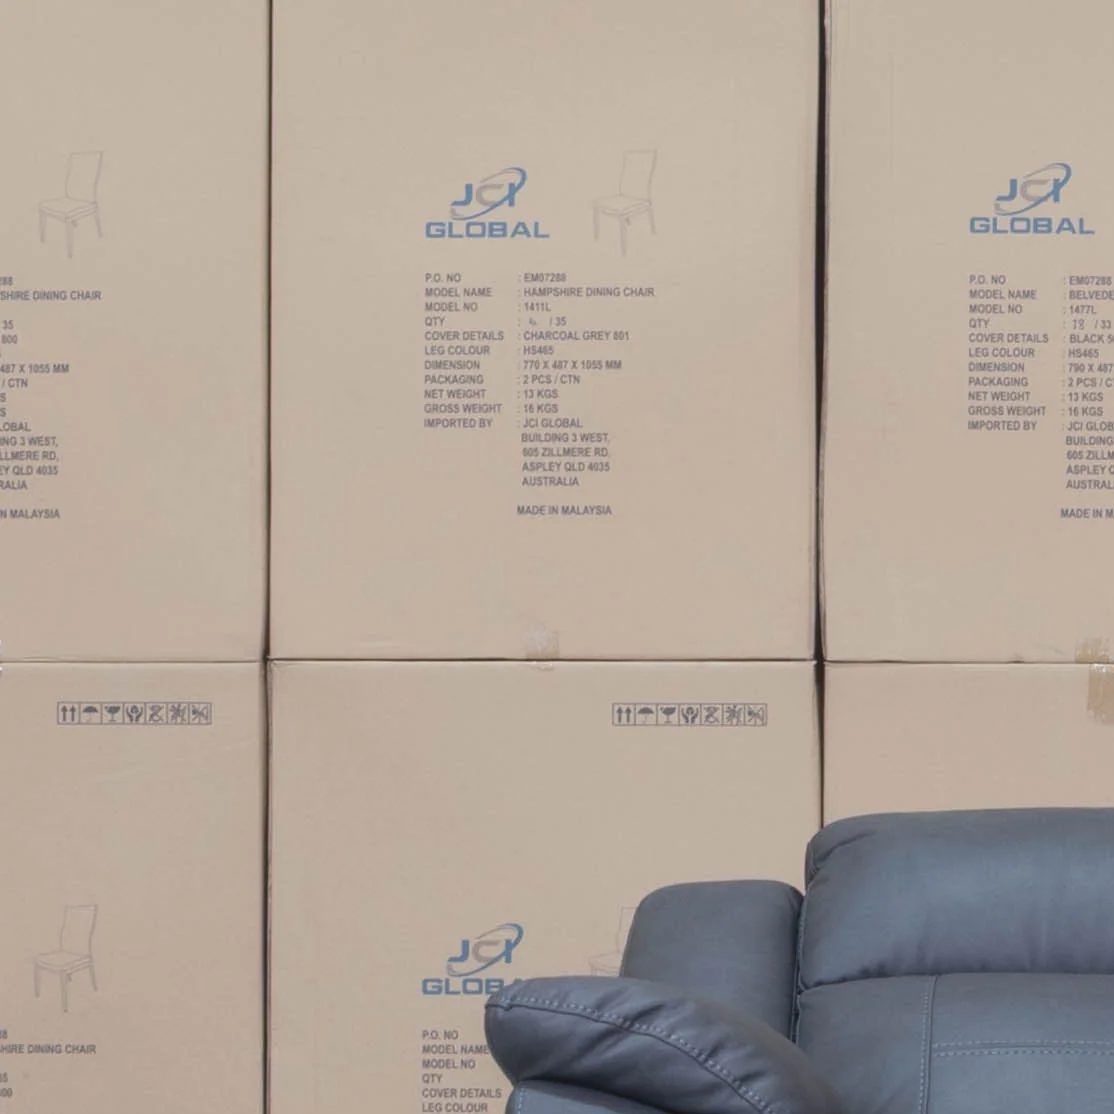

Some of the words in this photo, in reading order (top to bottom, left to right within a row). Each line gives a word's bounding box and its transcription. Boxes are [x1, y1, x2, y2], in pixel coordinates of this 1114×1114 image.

[426, 221, 550, 238] GLOBAL
[970, 217, 1095, 234] GLOBAL
[32, 290, 68, 301] DINING
[70, 290, 102, 301] CHAIR
[425, 287, 460, 297] MODEL
[463, 287, 493, 297] NAME
[524, 287, 583, 297] HAMPSHIRE
[586, 287, 621, 297] DINING
[623, 287, 655, 297] CHAIR
[969, 289, 1005, 299] MODEL
[1008, 289, 1037, 299] NAME
[424, 302, 461, 312] MODEL
[524, 302, 552, 312] 1411L
[969, 304, 1005, 314] MODEL
[1069, 304, 1097, 315] 1477L
[424, 316, 445, 327] QTY
[968, 318, 990, 329] QTY
[424, 331, 460, 341] COVER
[462, 331, 504, 341] DETAILS
[523, 330, 580, 341] CHARCOAL
[582, 330, 611, 341] GREY
[968, 333, 1004, 343] COVER
[1007, 333, 1049, 343] DETAILS
[1069, 334, 1105, 344] BLACK
[424, 345, 445, 356] LEG
[448, 345, 490, 356] COLOUR
[992, 347, 1036, 358] COLOUR
[424, 360, 480, 370] DIMENSION
[968, 362, 1025, 372] DIMENSION
[8, 378, 28, 388] CTN
[424, 374, 484, 384] PACKAGING
[531, 374, 552, 384] PCS
[559, 374, 581, 384] CTN
[968, 376, 1029, 387] PACKAGING
[424, 389, 444, 399] NET
[446, 389, 487, 399] WEIGHT
[537, 389, 559, 399] KGS
[991, 391, 1031, 401] WEIGHT
[424, 403, 460, 414] GROSS
[462, 403, 504, 414] WEIGHT
[537, 403, 559, 414] KGS
[967, 406, 1004, 416] GROSS
[1007, 406, 1046, 416] WEIGHT
[424, 418, 476, 428] IMPORTED
[541, 418, 583, 428] GLOBAL
[967, 420, 1021, 431] IMPORTED
[521, 432, 569, 443] BUILDING
[1065, 436, 1114, 446] BUILDING
[541, 447, 591, 457] ZILLMERE
[12, 465, 33, 476] QLD
[522, 461, 562, 472] ASPLEY
[1066, 464, 1106, 475] ASPLEY
[521, 476, 580, 487] AUSTRALIA
[10, 509, 61, 519] MALAYSIA
[517, 505, 546, 515] MADE
[561, 505, 612, 515] MALAYSIA
[1060, 508, 1090, 519] MADE
[27, 1044, 63, 1054] DINING
[64, 1044, 96, 1054] CHAIR
[422, 1044, 458, 1054] MODEL
[460, 1044, 489, 1054] NAME
[422, 1059, 458, 1069] MODEL
[422, 1073, 443, 1084] QTY
[422, 1088, 458, 1098] COVER
[459, 1088, 502, 1098] DETAILS
[445, 1102, 488, 1113] COLOUR
